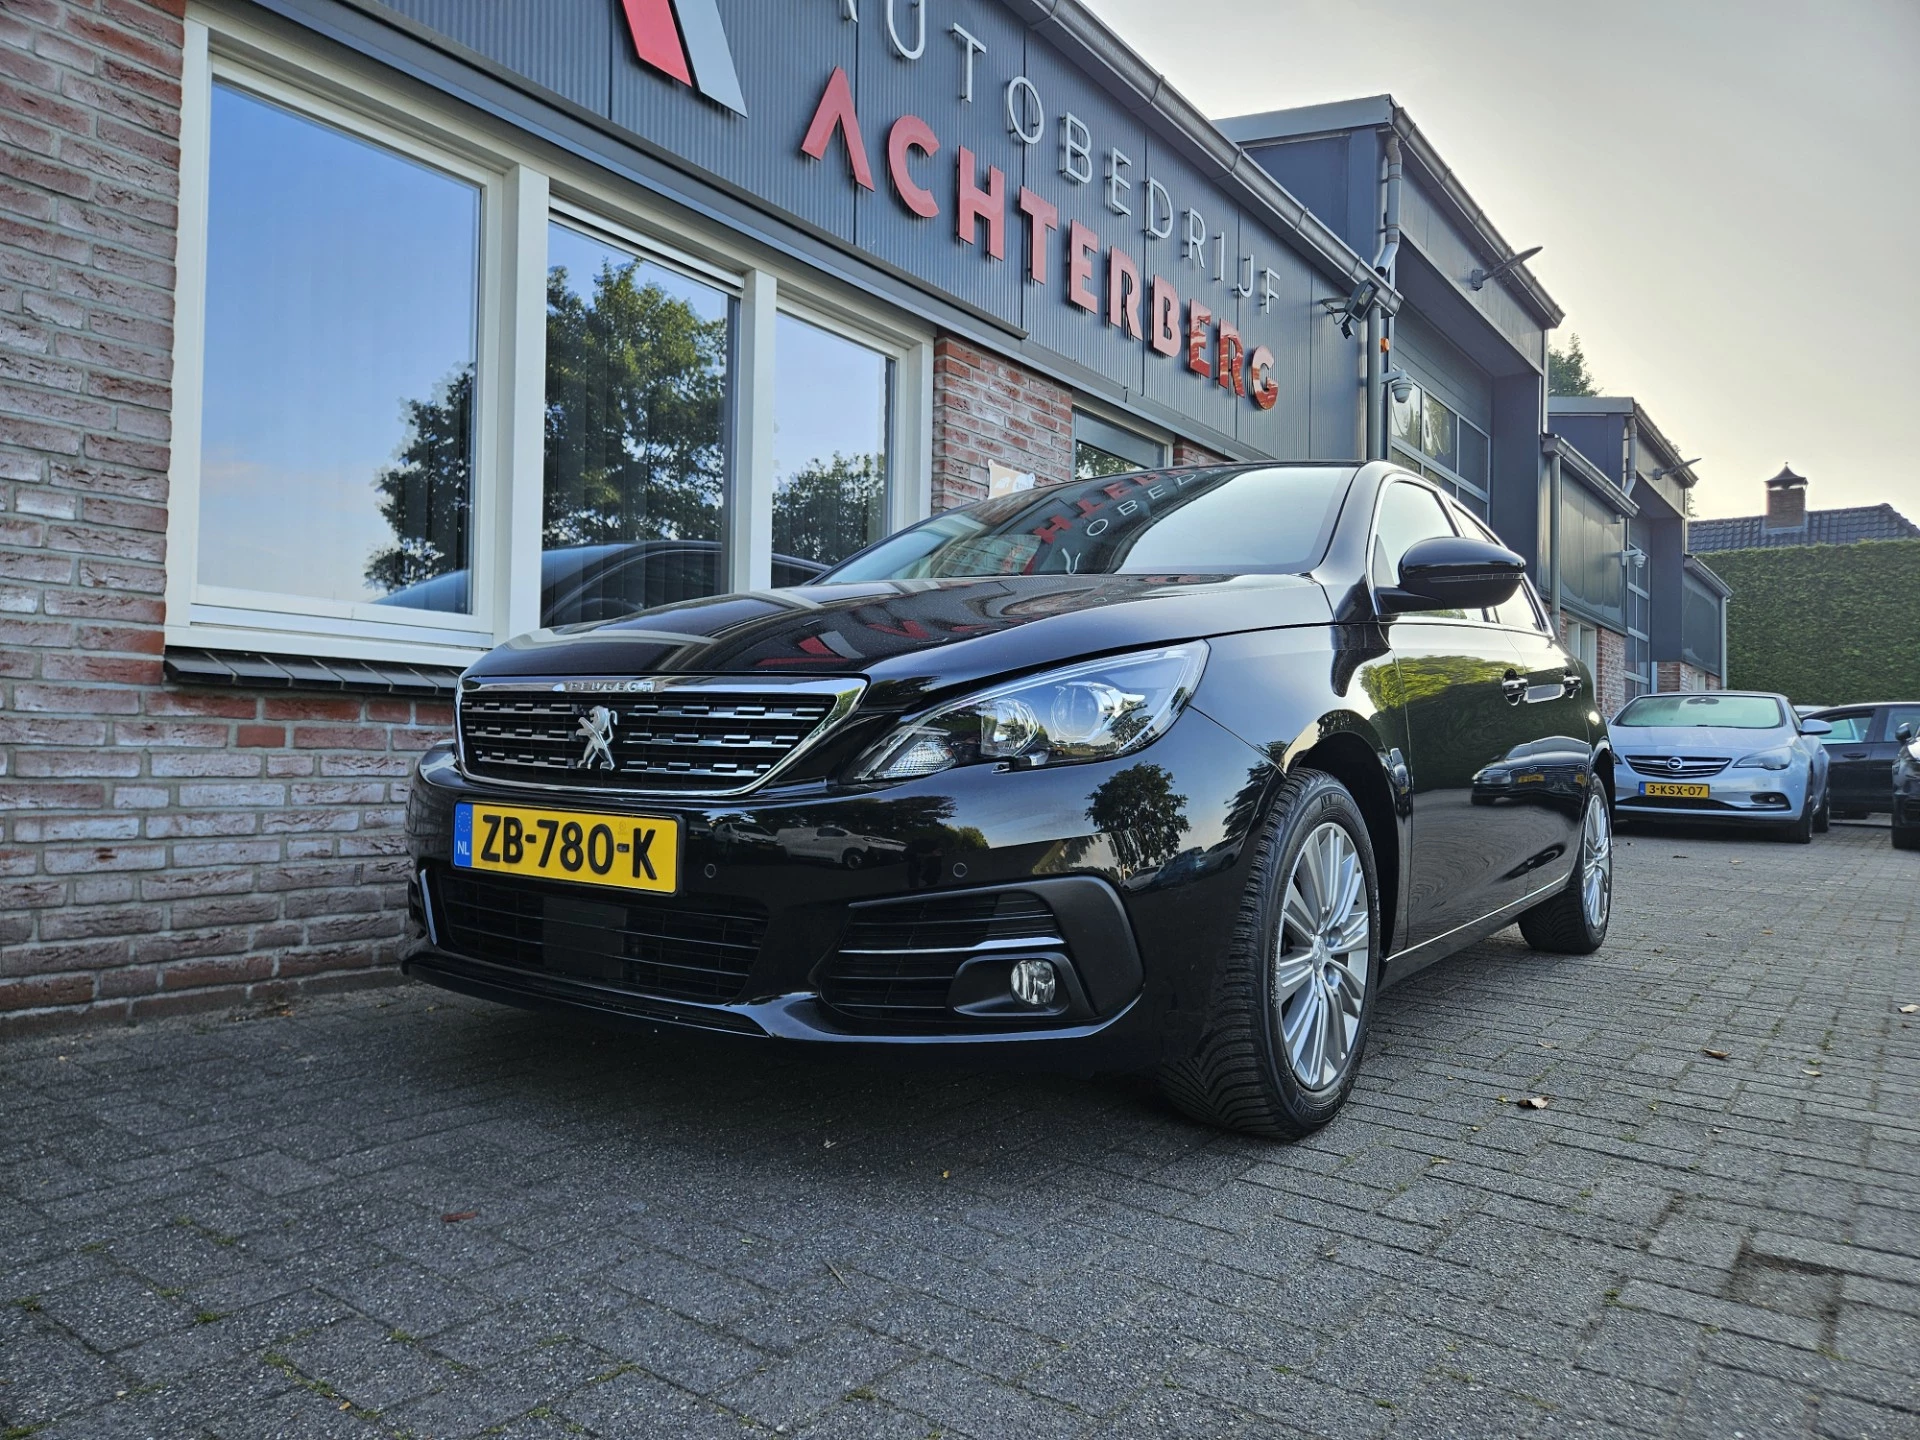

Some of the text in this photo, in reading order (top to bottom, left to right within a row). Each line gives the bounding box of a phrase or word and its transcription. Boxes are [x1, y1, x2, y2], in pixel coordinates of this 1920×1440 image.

[846, 0, 1280, 314] UTOBEDRIJF
[801, 65, 1279, 410] ACHTERBERG
[1648, 784, 1703, 796] 3-KSX-07
[457, 841, 470, 856] NL
[481, 814, 657, 880] ZB-780-K
